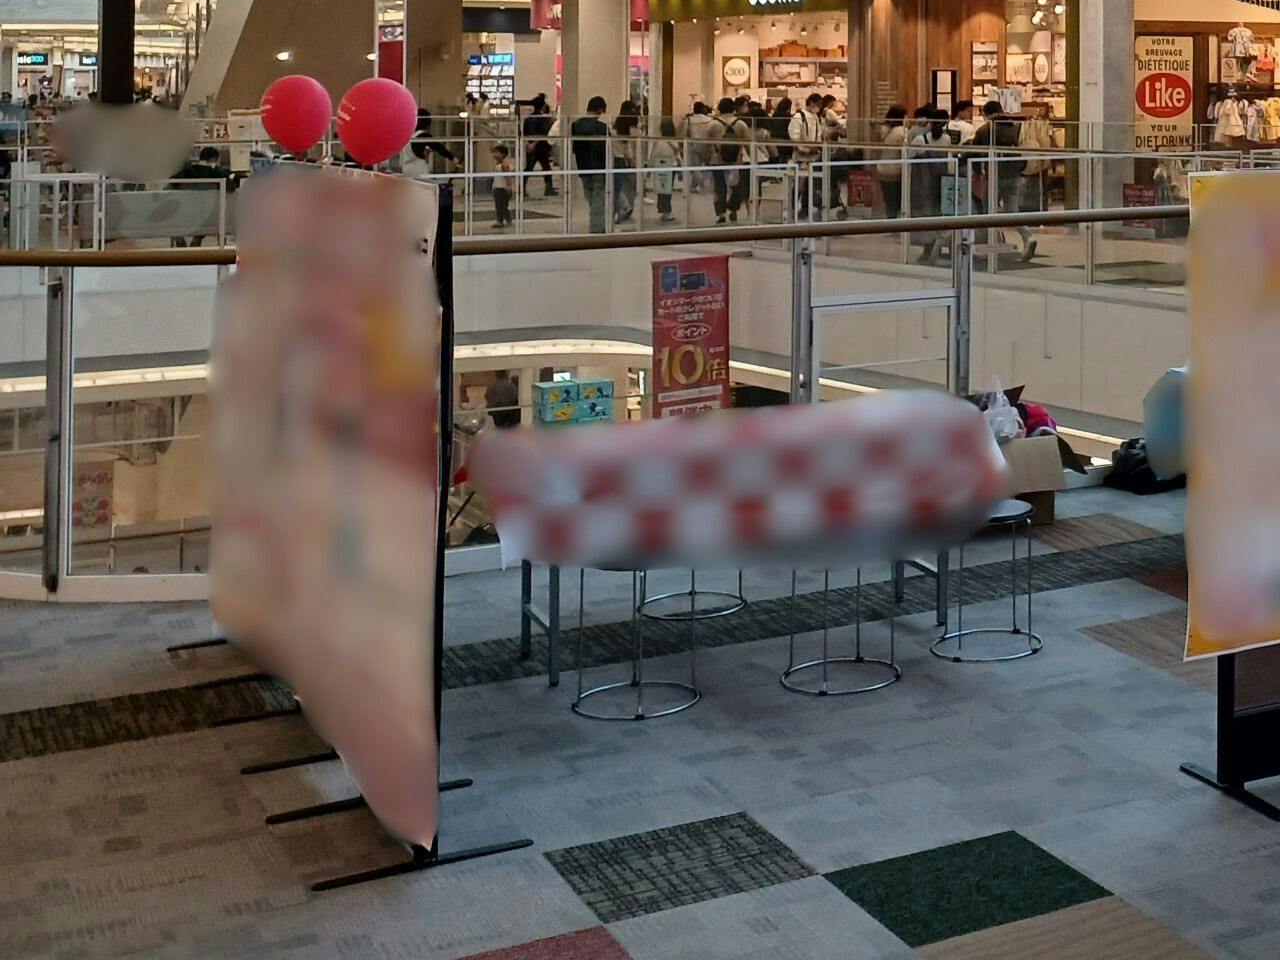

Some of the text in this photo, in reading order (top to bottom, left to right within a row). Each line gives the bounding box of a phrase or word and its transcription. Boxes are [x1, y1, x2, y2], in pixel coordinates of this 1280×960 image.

[1151, 38, 1176, 46] VOTRE
[1145, 77, 1186, 108] Like
[1150, 124, 1178, 132] YOUR
[1136, 135, 1159, 148] DIET
